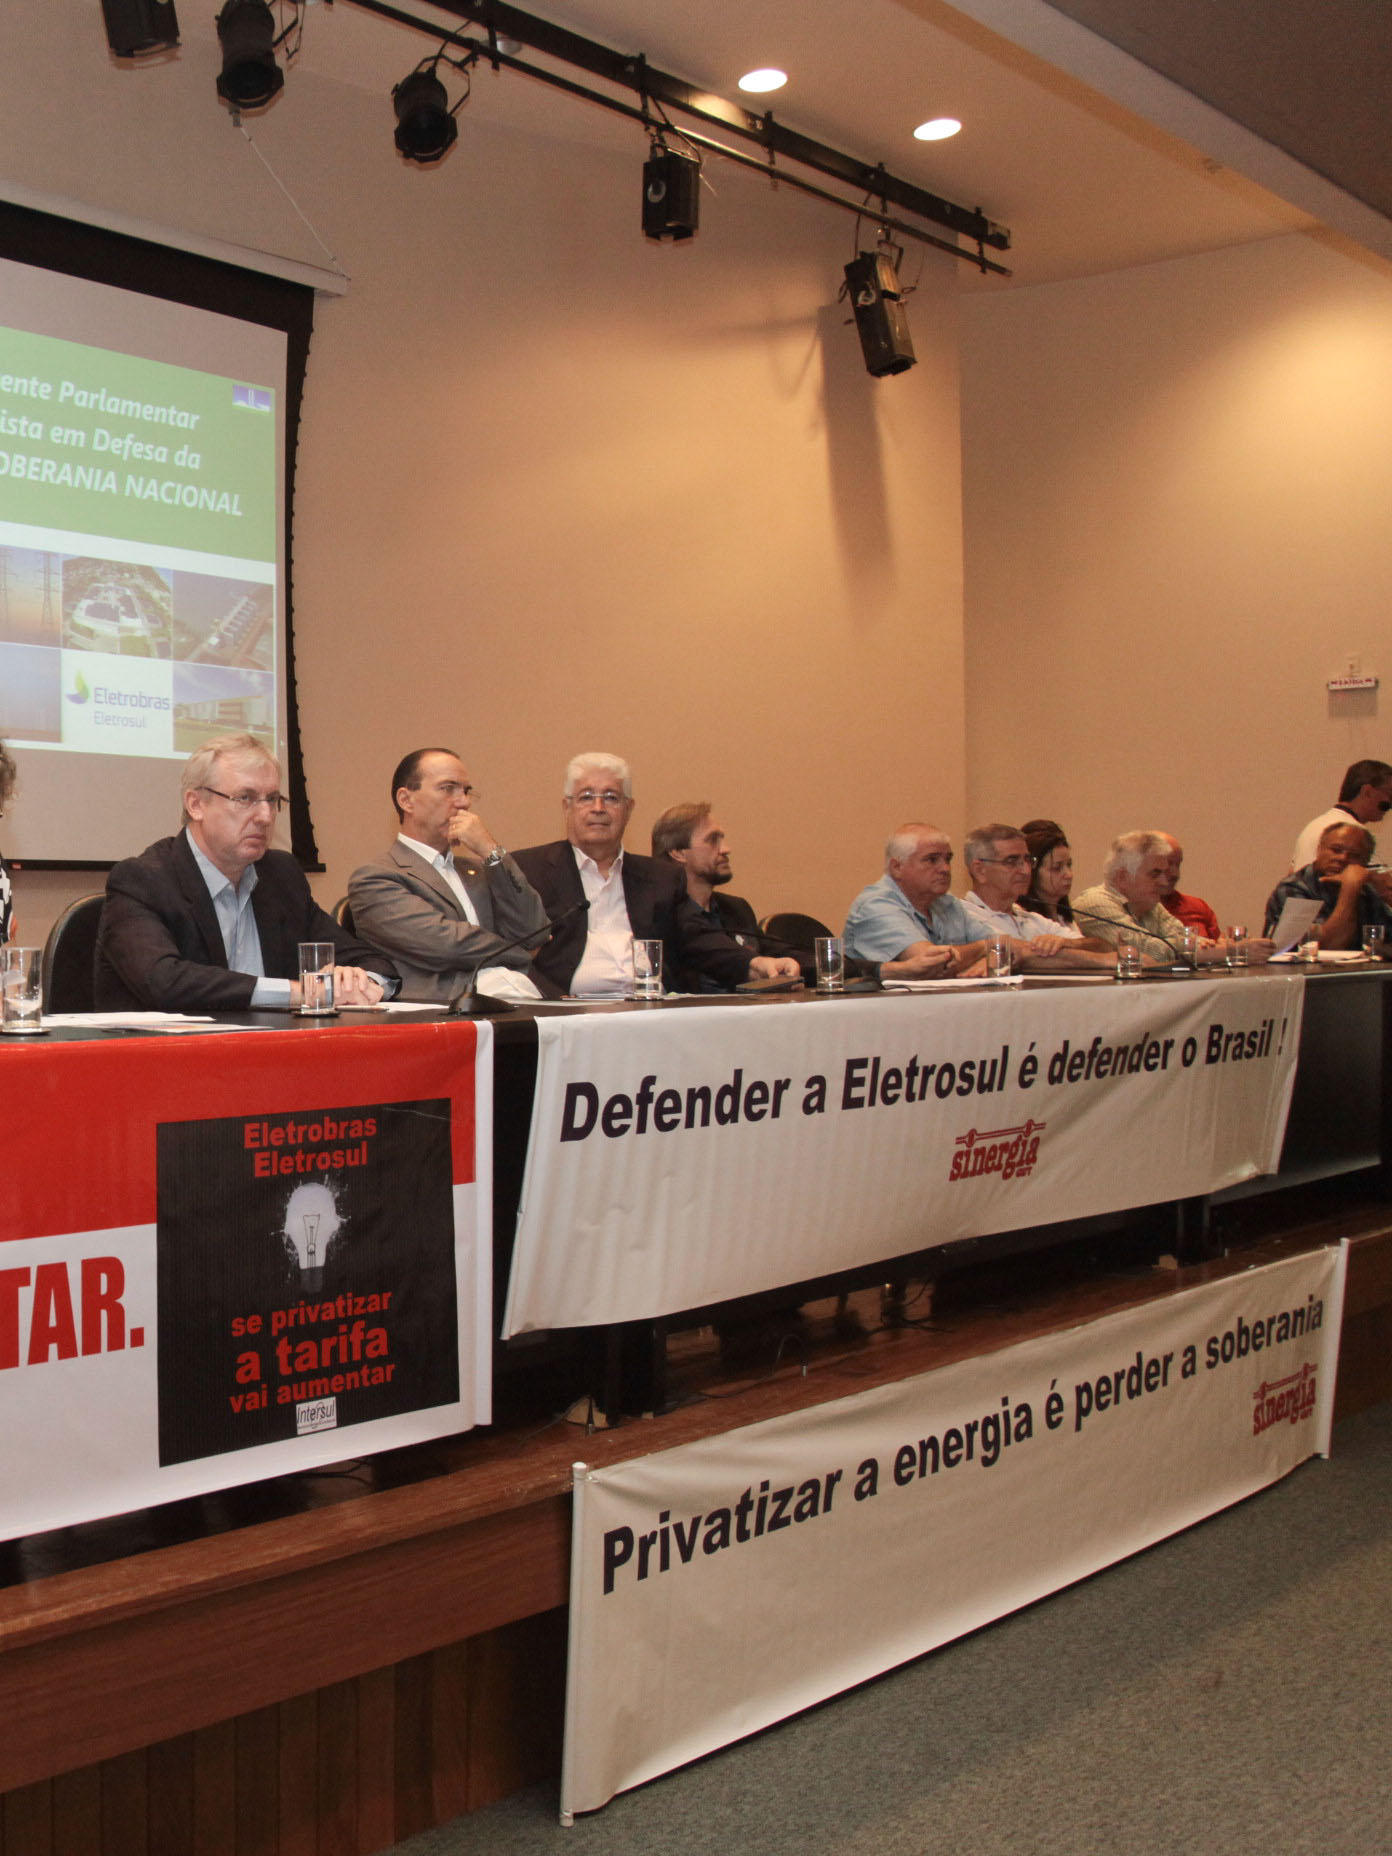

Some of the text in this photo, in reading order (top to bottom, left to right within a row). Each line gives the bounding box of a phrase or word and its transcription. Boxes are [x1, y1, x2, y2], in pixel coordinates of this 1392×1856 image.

[58, 381, 200, 430] Parlamentar
[50, 426, 85, 448] em
[93, 428, 168, 461] Defesa
[174, 445, 201, 470] da
[125, 475, 243, 516] NACIONAL
[94, 687, 170, 710] Eletrobras
[94, 711, 146, 728] Eletrosul
[559, 1069, 790, 1142] Defender
[803, 1075, 827, 1114] a
[840, 1046, 1009, 1110] Eletrosul
[1018, 1040, 1039, 1089] é
[1048, 1032, 1175, 1085] defender
[1182, 1037, 1197, 1067] o
[1205, 1019, 1275, 1064] Brasil
[244, 1116, 377, 1148] Eletrobras
[254, 1141, 368, 1177] Eletrosul
[231, 1292, 392, 1337] se privatizar
[235, 1321, 389, 1384] a tarifa
[230, 1364, 395, 1413] vai aumentar
[296, 1400, 335, 1424] Intersul
[602, 1294, 1323, 1595] Privatizar a energia é perder a soberania
